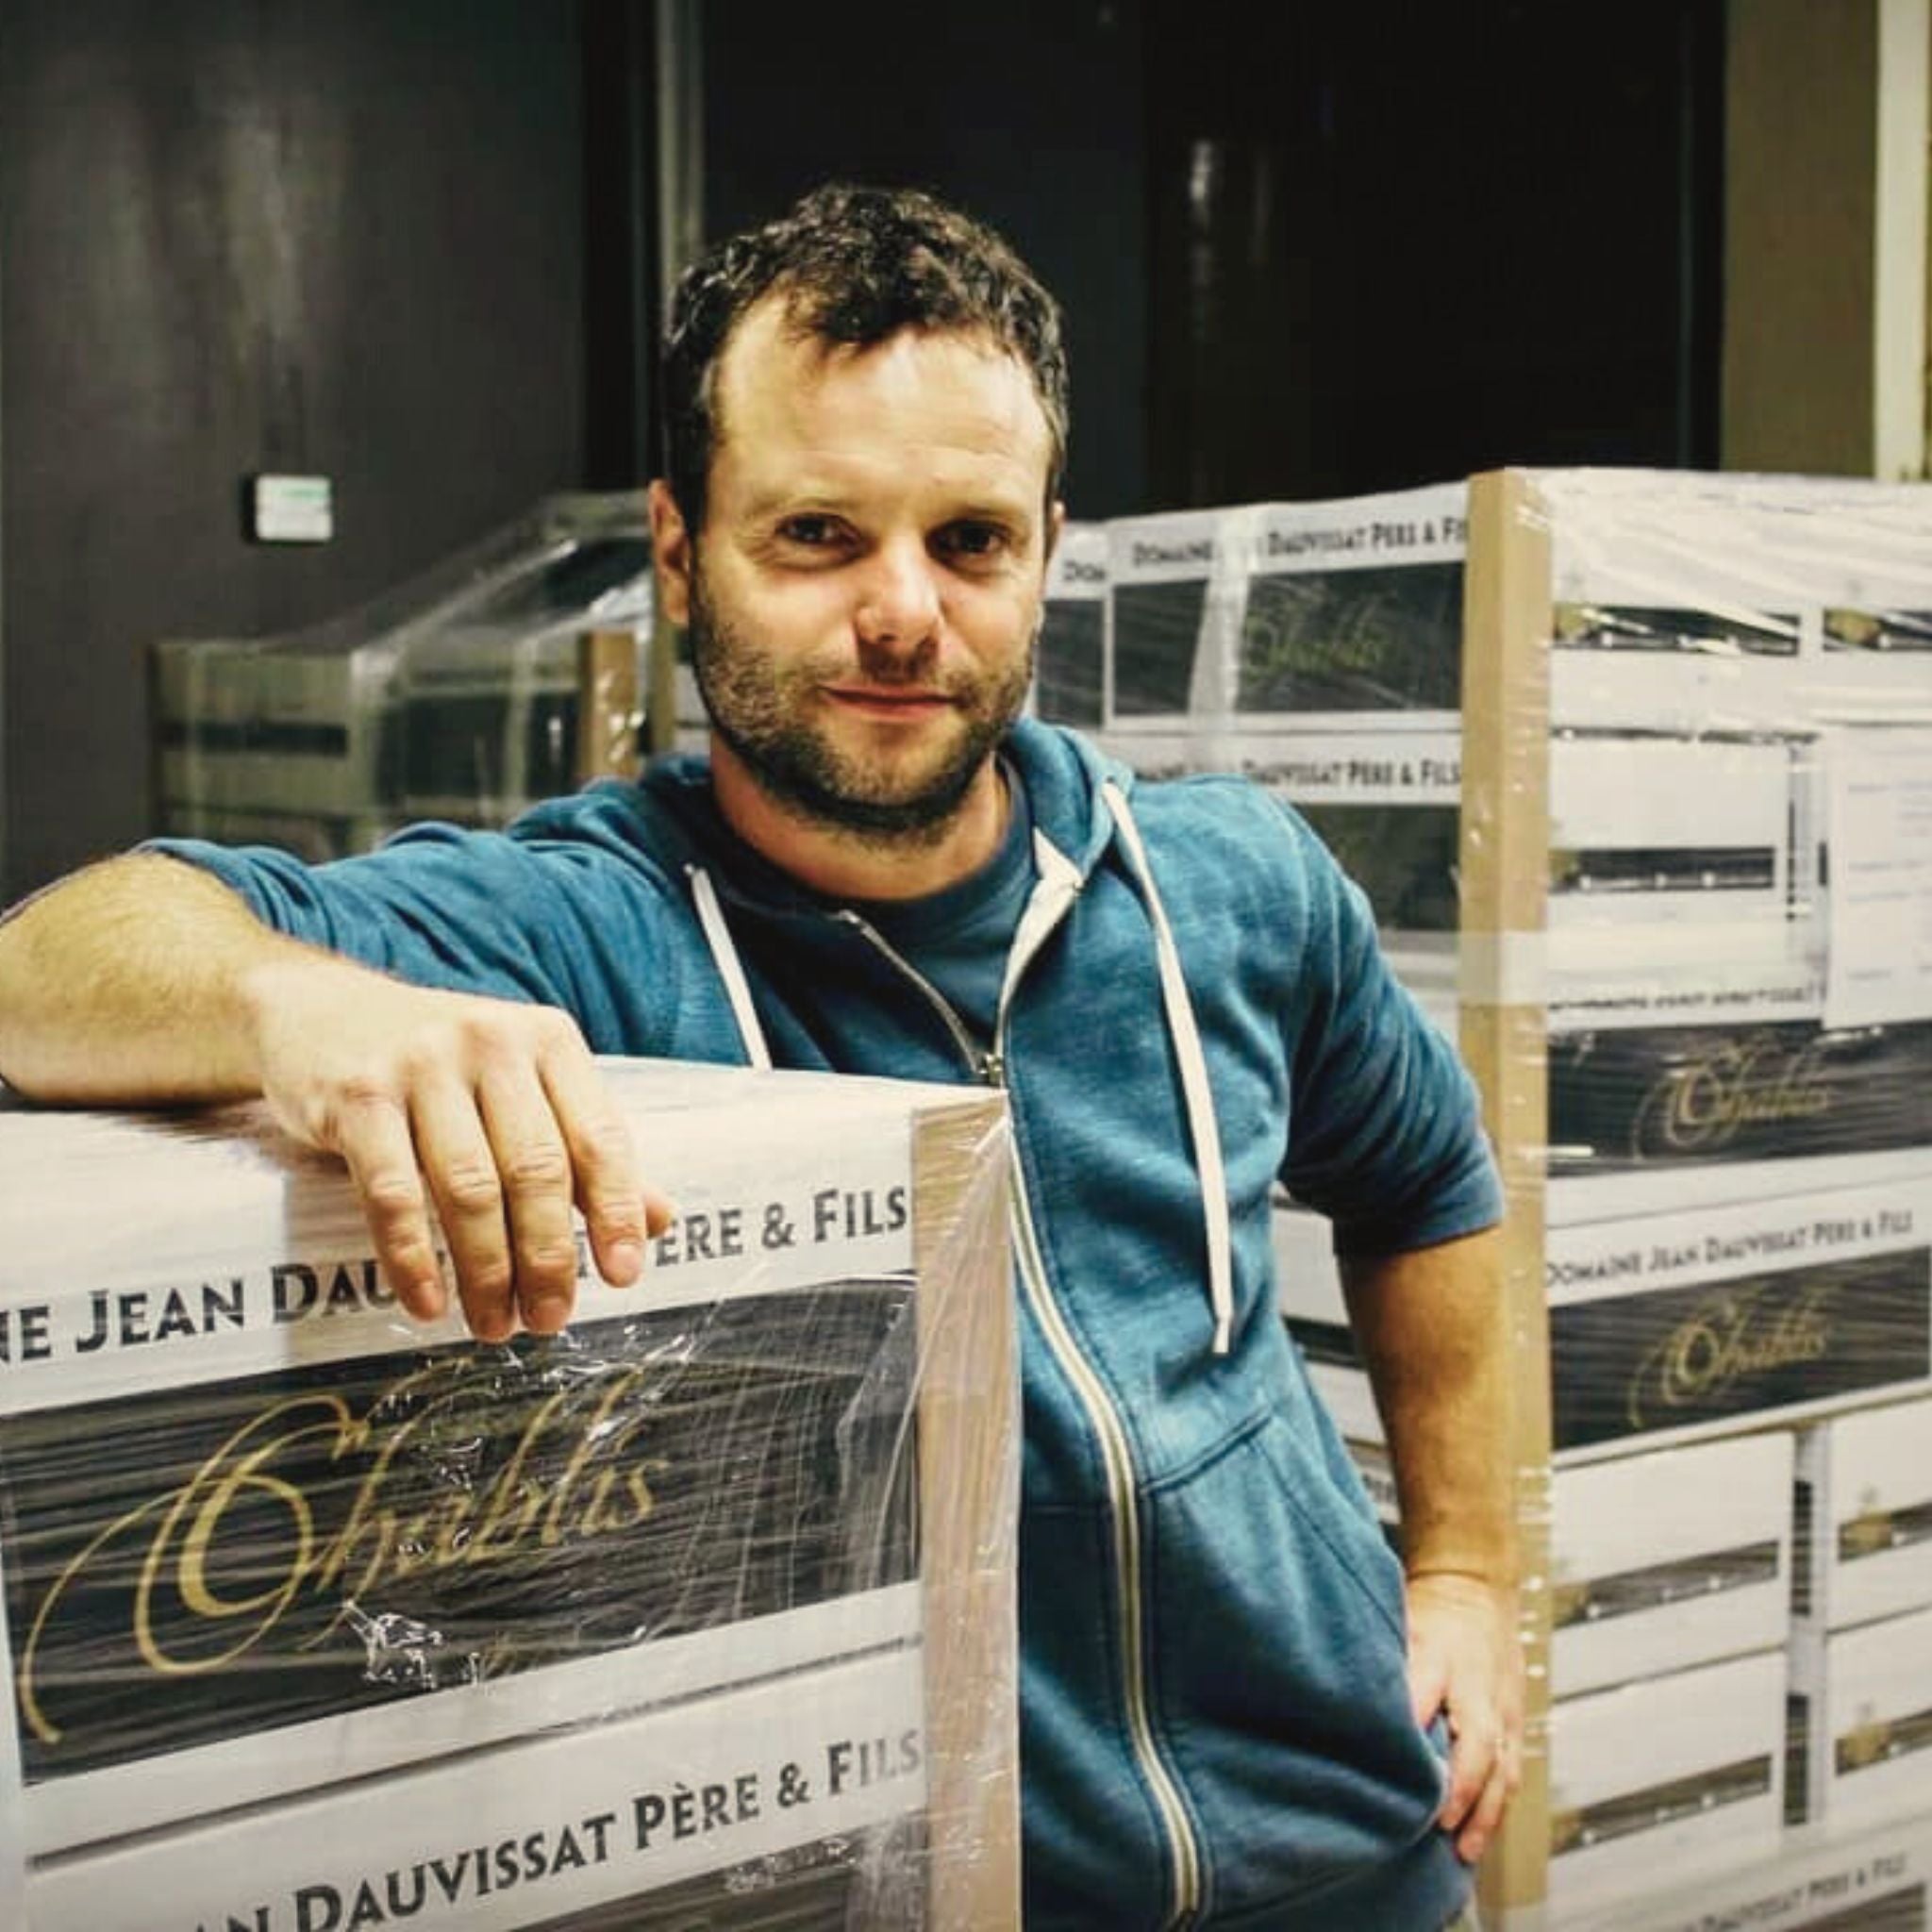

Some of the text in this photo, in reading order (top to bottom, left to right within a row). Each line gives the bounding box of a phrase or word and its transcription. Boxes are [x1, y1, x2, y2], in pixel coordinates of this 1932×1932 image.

[75, 1278, 245, 1354] JEAN
[761, 1203, 794, 1249] &
[813, 1186, 908, 1242] FILS
[21, 1357, 670, 1744] Chablis
[293, 1729, 923, 1932] DAUVISSAT PÈRE & FILS
